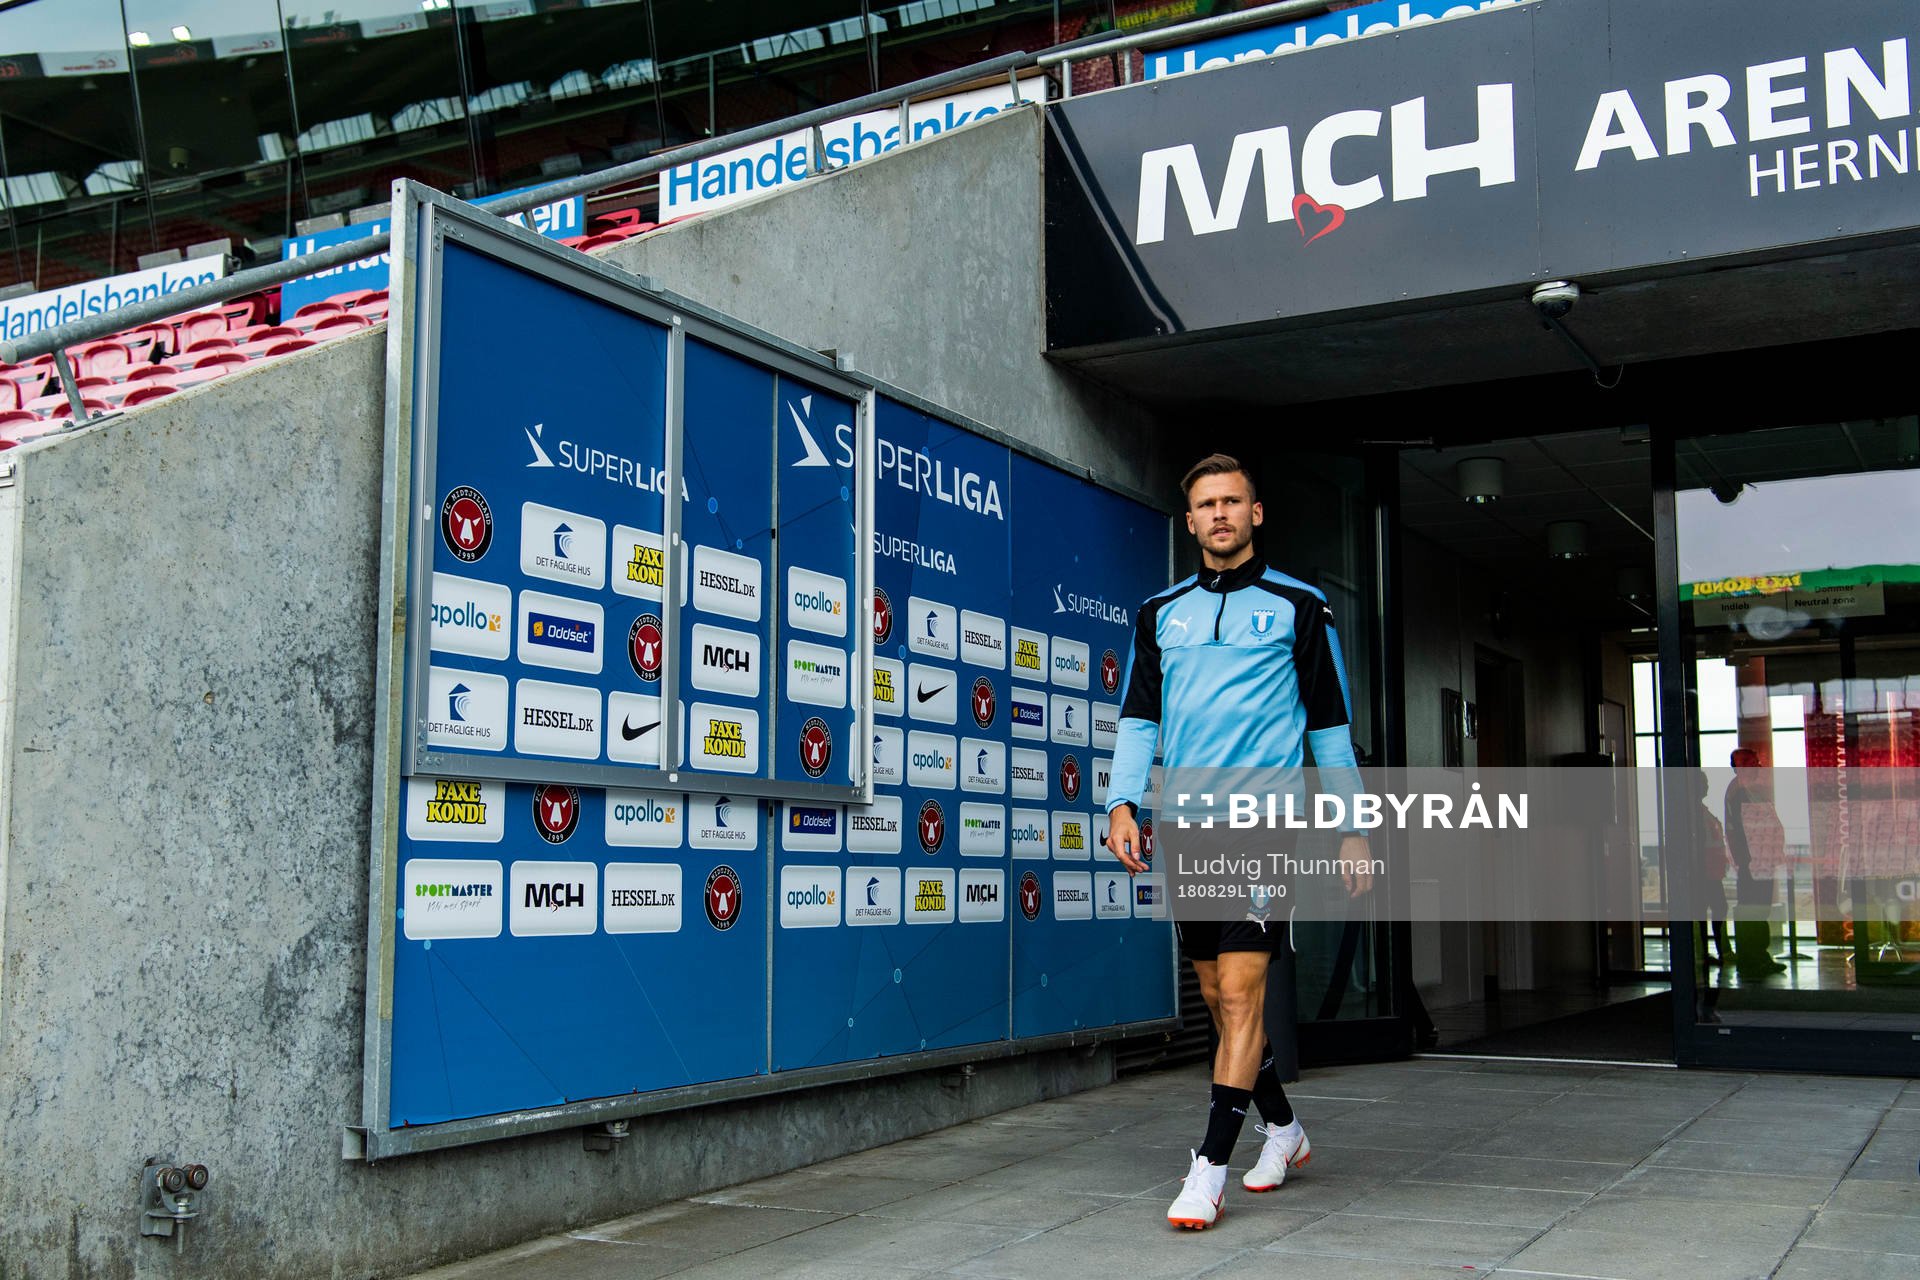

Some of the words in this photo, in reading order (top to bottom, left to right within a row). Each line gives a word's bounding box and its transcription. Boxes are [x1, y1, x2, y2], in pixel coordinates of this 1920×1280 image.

[1136, 83, 1515, 245] MCH
[1575, 37, 1920, 172] AREN
[835, 423, 1004, 520] SPERLIGA
[634, 544, 664, 567] FAX
[873, 531, 957, 576] SUPERLIGA
[536, 556, 549, 568] DET
[550, 558, 576, 574] FAGLIGE
[577, 561, 591, 576] HUS
[699, 571, 756, 598] HESSEL.DK
[795, 591, 832, 613] apollo
[1067, 593, 1129, 626] SUPERLIGA
[1794, 598, 1829, 608] Neutral
[431, 601, 487, 630] apollo
[547, 625, 588, 644] Oddset
[964, 630, 1002, 650] HESSEL.DK
[1018, 639, 1038, 656] FAXE
[702, 644, 750, 672] MCH
[794, 660, 841, 676] SPORTMASTER
[1015, 651, 1040, 670] KONDI
[1055, 654, 1080, 672] apollo
[428, 722, 442, 733] DET
[444, 723, 475, 737] FAGLIGE
[475, 727, 491, 737] HUS
[523, 707, 594, 732] HESSEL.DK
[709, 719, 742, 740] FAXE
[704, 736, 746, 758] KONDI
[912, 749, 945, 771] apollo
[435, 779, 482, 803] FAXE
[426, 801, 487, 824] KONDI
[614, 799, 664, 826] apollo
[802, 815, 832, 828] Oddset
[852, 815, 898, 833] HESSEL.DK
[964, 818, 1001, 830] SPORTMASTER
[1012, 823, 1039, 844] apollo
[1062, 822, 1081, 836] FAXE
[701, 829, 712, 839] DET
[712, 830, 734, 840] FAGLIGE
[734, 831, 746, 840] HUS
[1059, 834, 1084, 849] KONDI
[415, 883, 493, 897] SPORTMASTER
[524, 883, 585, 909] MCH
[611, 889, 676, 907] HESSEL.DK
[787, 884, 827, 909] apollo
[919, 880, 943, 896] FAXE
[966, 884, 998, 903] MCH
[1057, 889, 1089, 902] HESSEL.DK
[882, 908, 892, 916] HUS
[915, 894, 946, 911] KONDI
